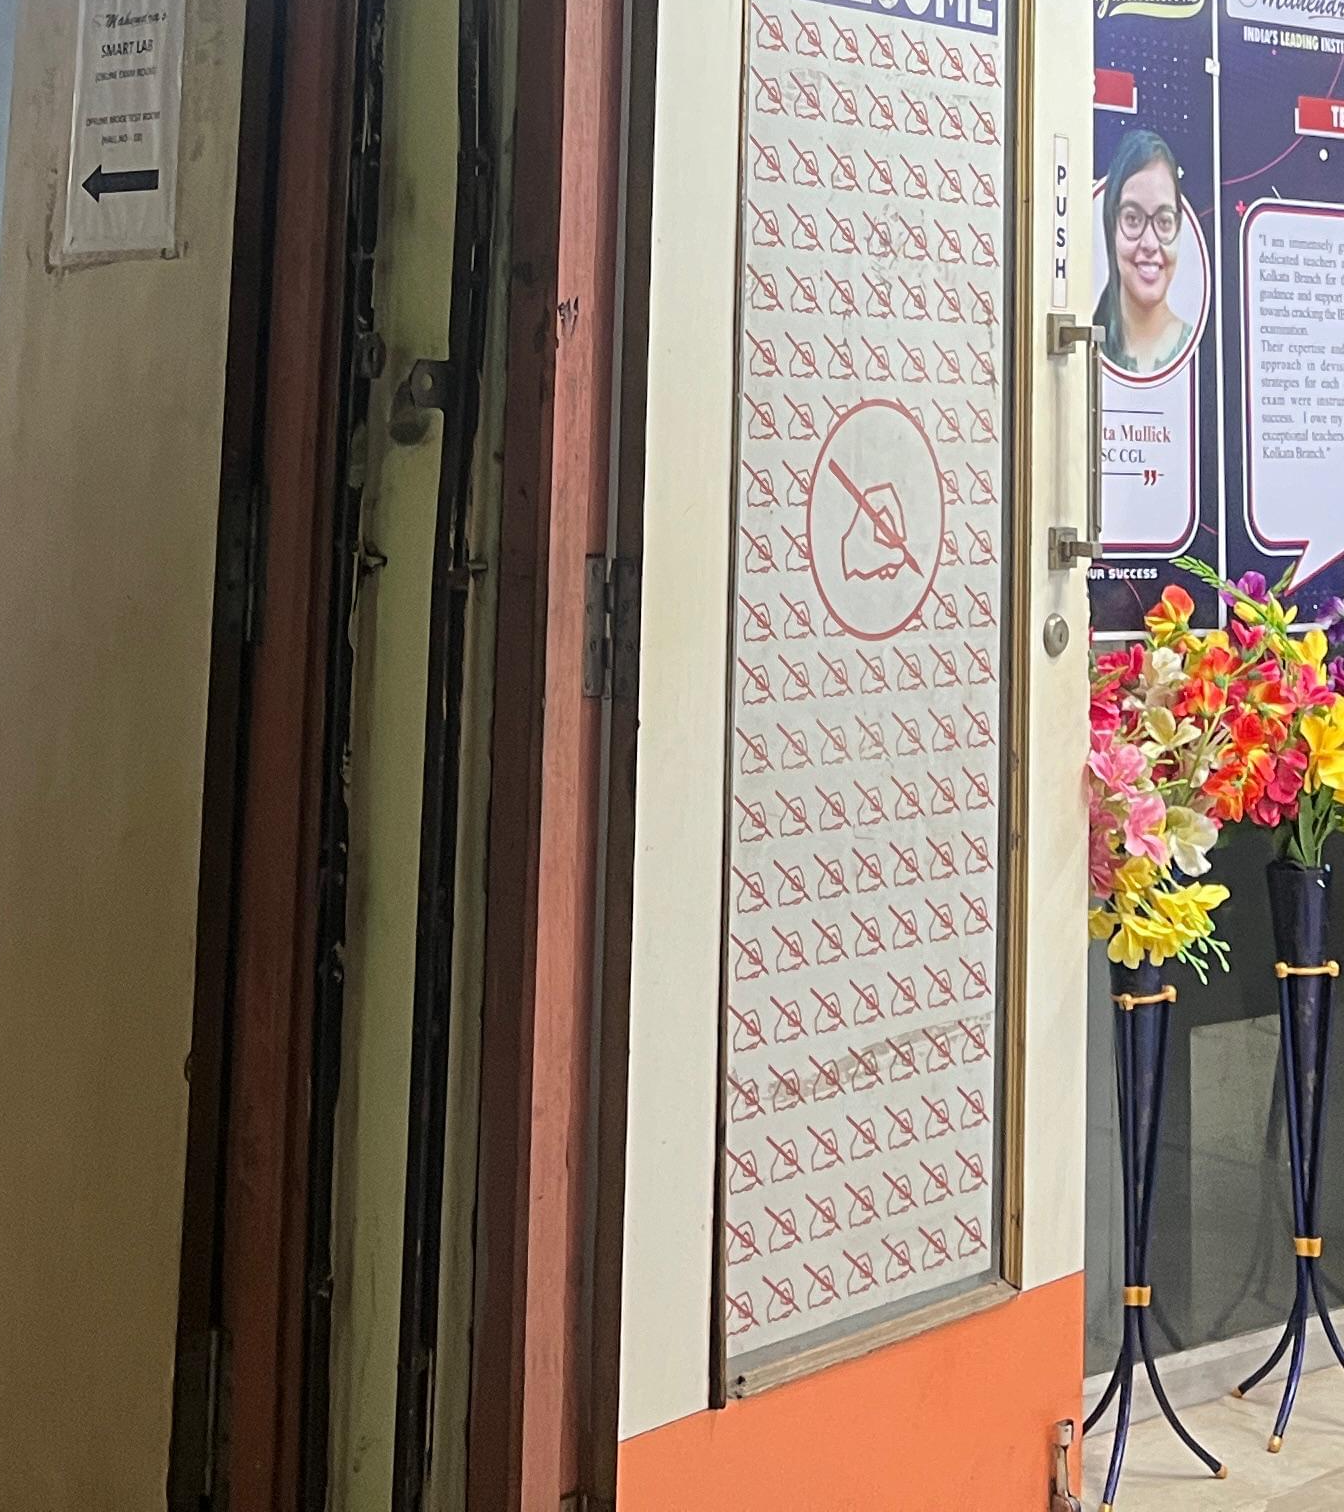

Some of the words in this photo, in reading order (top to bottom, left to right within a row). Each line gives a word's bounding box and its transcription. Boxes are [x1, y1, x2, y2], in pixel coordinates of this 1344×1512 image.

[1244, 26, 1278, 45] INDIA'S
[1280, 31, 1318, 51] LEADING
[101, 41, 135, 58] SMART
[137, 39, 153, 54] LAB
[1056, 165, 1067, 279] PUSH
[1103, 427, 1115, 440] ta
[1121, 425, 1171, 442] Mullick
[1101, 448, 1116, 462] SC
[1120, 449, 1146, 463] CGL
[1088, 568, 1104, 579] UR
[1108, 568, 1157, 579] SUCCESS
